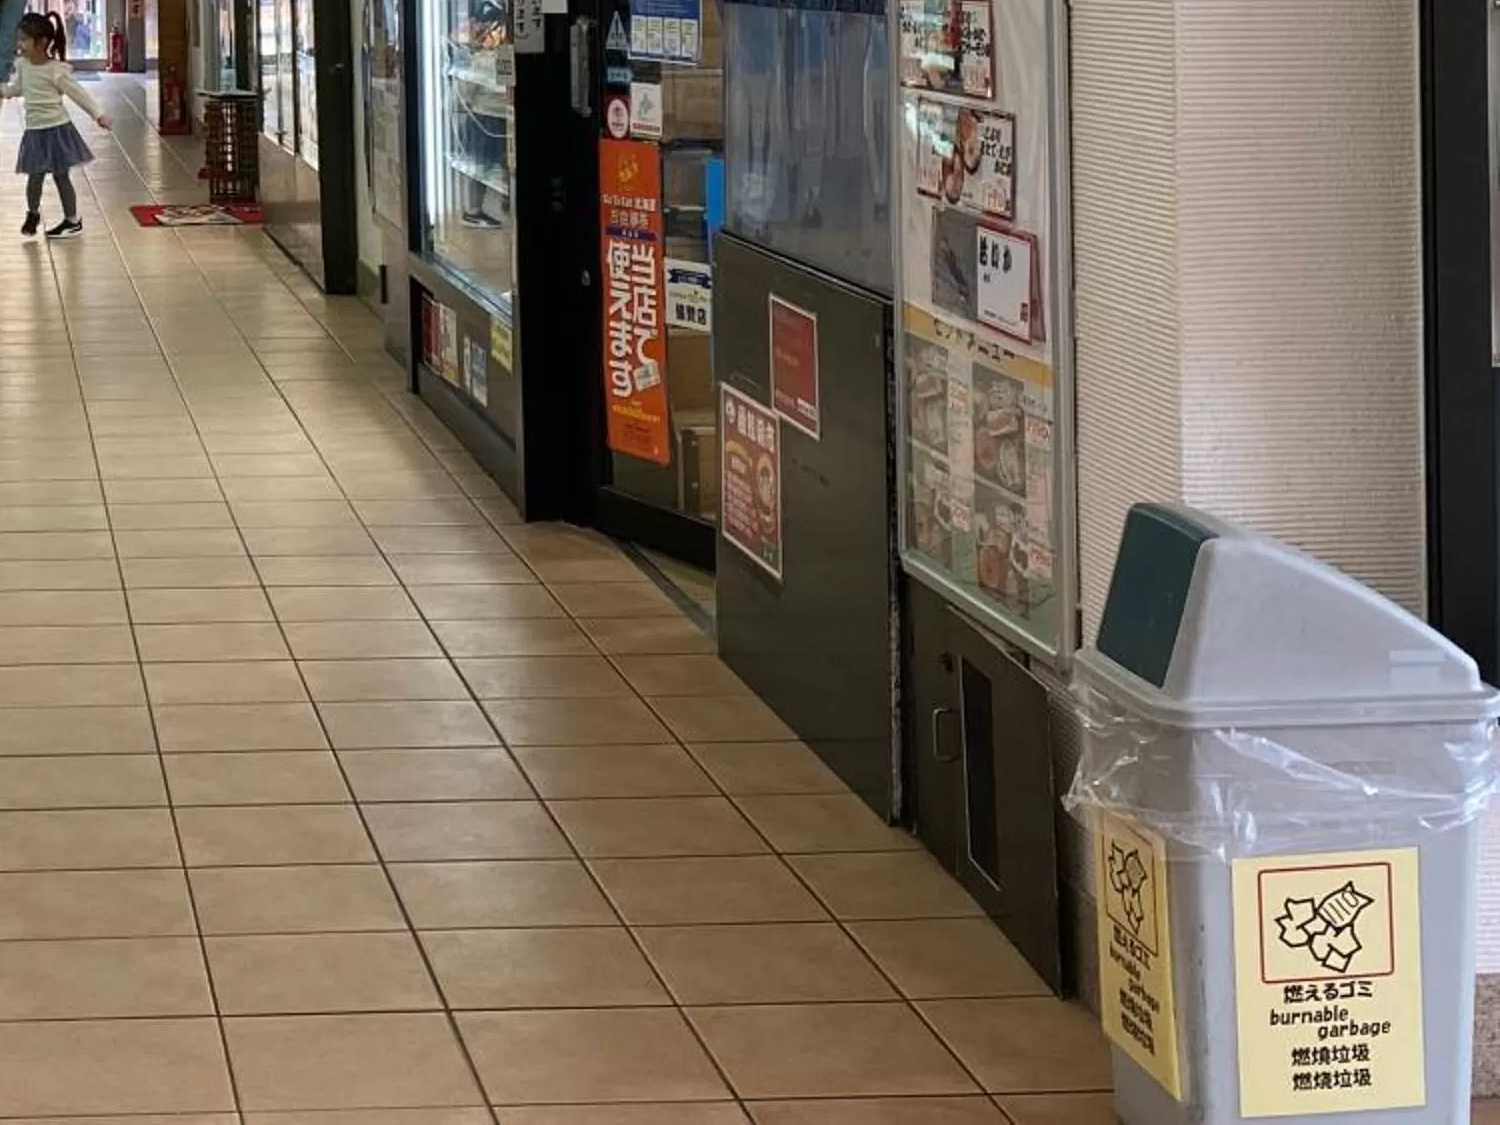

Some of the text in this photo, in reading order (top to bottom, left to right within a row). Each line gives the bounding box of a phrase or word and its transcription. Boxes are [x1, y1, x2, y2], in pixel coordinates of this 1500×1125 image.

[632, 244, 658, 362] 当店で
[607, 242, 633, 398] 使えます
[1283, 982, 1374, 1003] 燃えるゴミ
[1270, 1006, 1349, 1026] burnable
[1317, 1019, 1391, 1039] garbage
